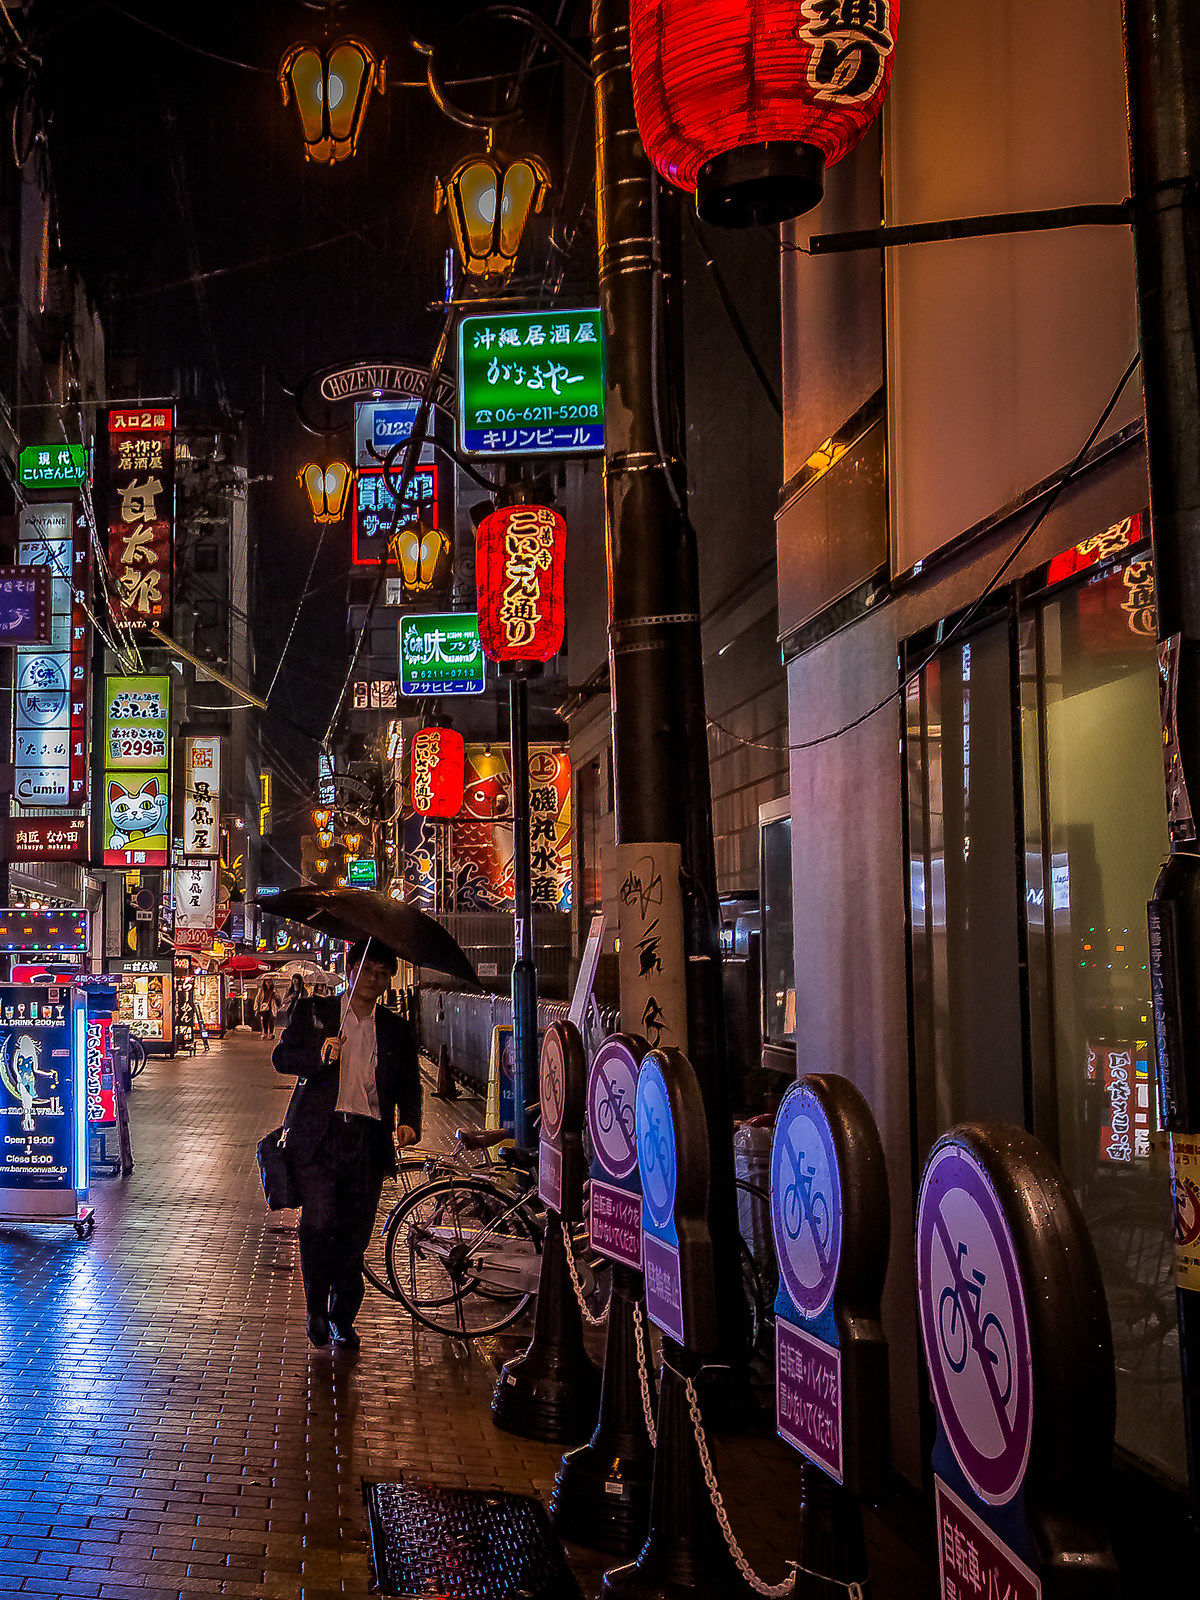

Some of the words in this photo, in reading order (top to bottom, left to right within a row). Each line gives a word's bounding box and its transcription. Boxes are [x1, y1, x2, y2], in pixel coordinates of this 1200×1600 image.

[474, 322, 597, 350] 沖縄居酒屋
[495, 404, 599, 422] 06-6211-5208
[114, 414, 166, 428] 入口2階
[482, 427, 591, 448] キリンビール
[119, 440, 163, 453] 手作り
[38, 452, 70, 465] 現代
[118, 457, 163, 470] 居酒屋
[23, 467, 85, 481] こいさんビル
[117, 476, 165, 614] 甘太郎
[501, 511, 542, 647] こいさん通り
[420, 668, 475, 678] 6211-0713
[410, 681, 476, 693] アサヒビール
[121, 740, 166, 756] 299円
[18, 778, 65, 798] Cumin
[530, 787, 560, 904] 磯丸水産
[124, 850, 146, 863] 1階
[9, 1018, 33, 1026] DRINK
[35, 1018, 65, 1027] 200yen
[4, 1136, 25, 1145] Open
[27, 1136, 54, 1145] 19:00
[6, 1154, 30, 1164] Close
[31, 1154, 53, 1163] 5:00
